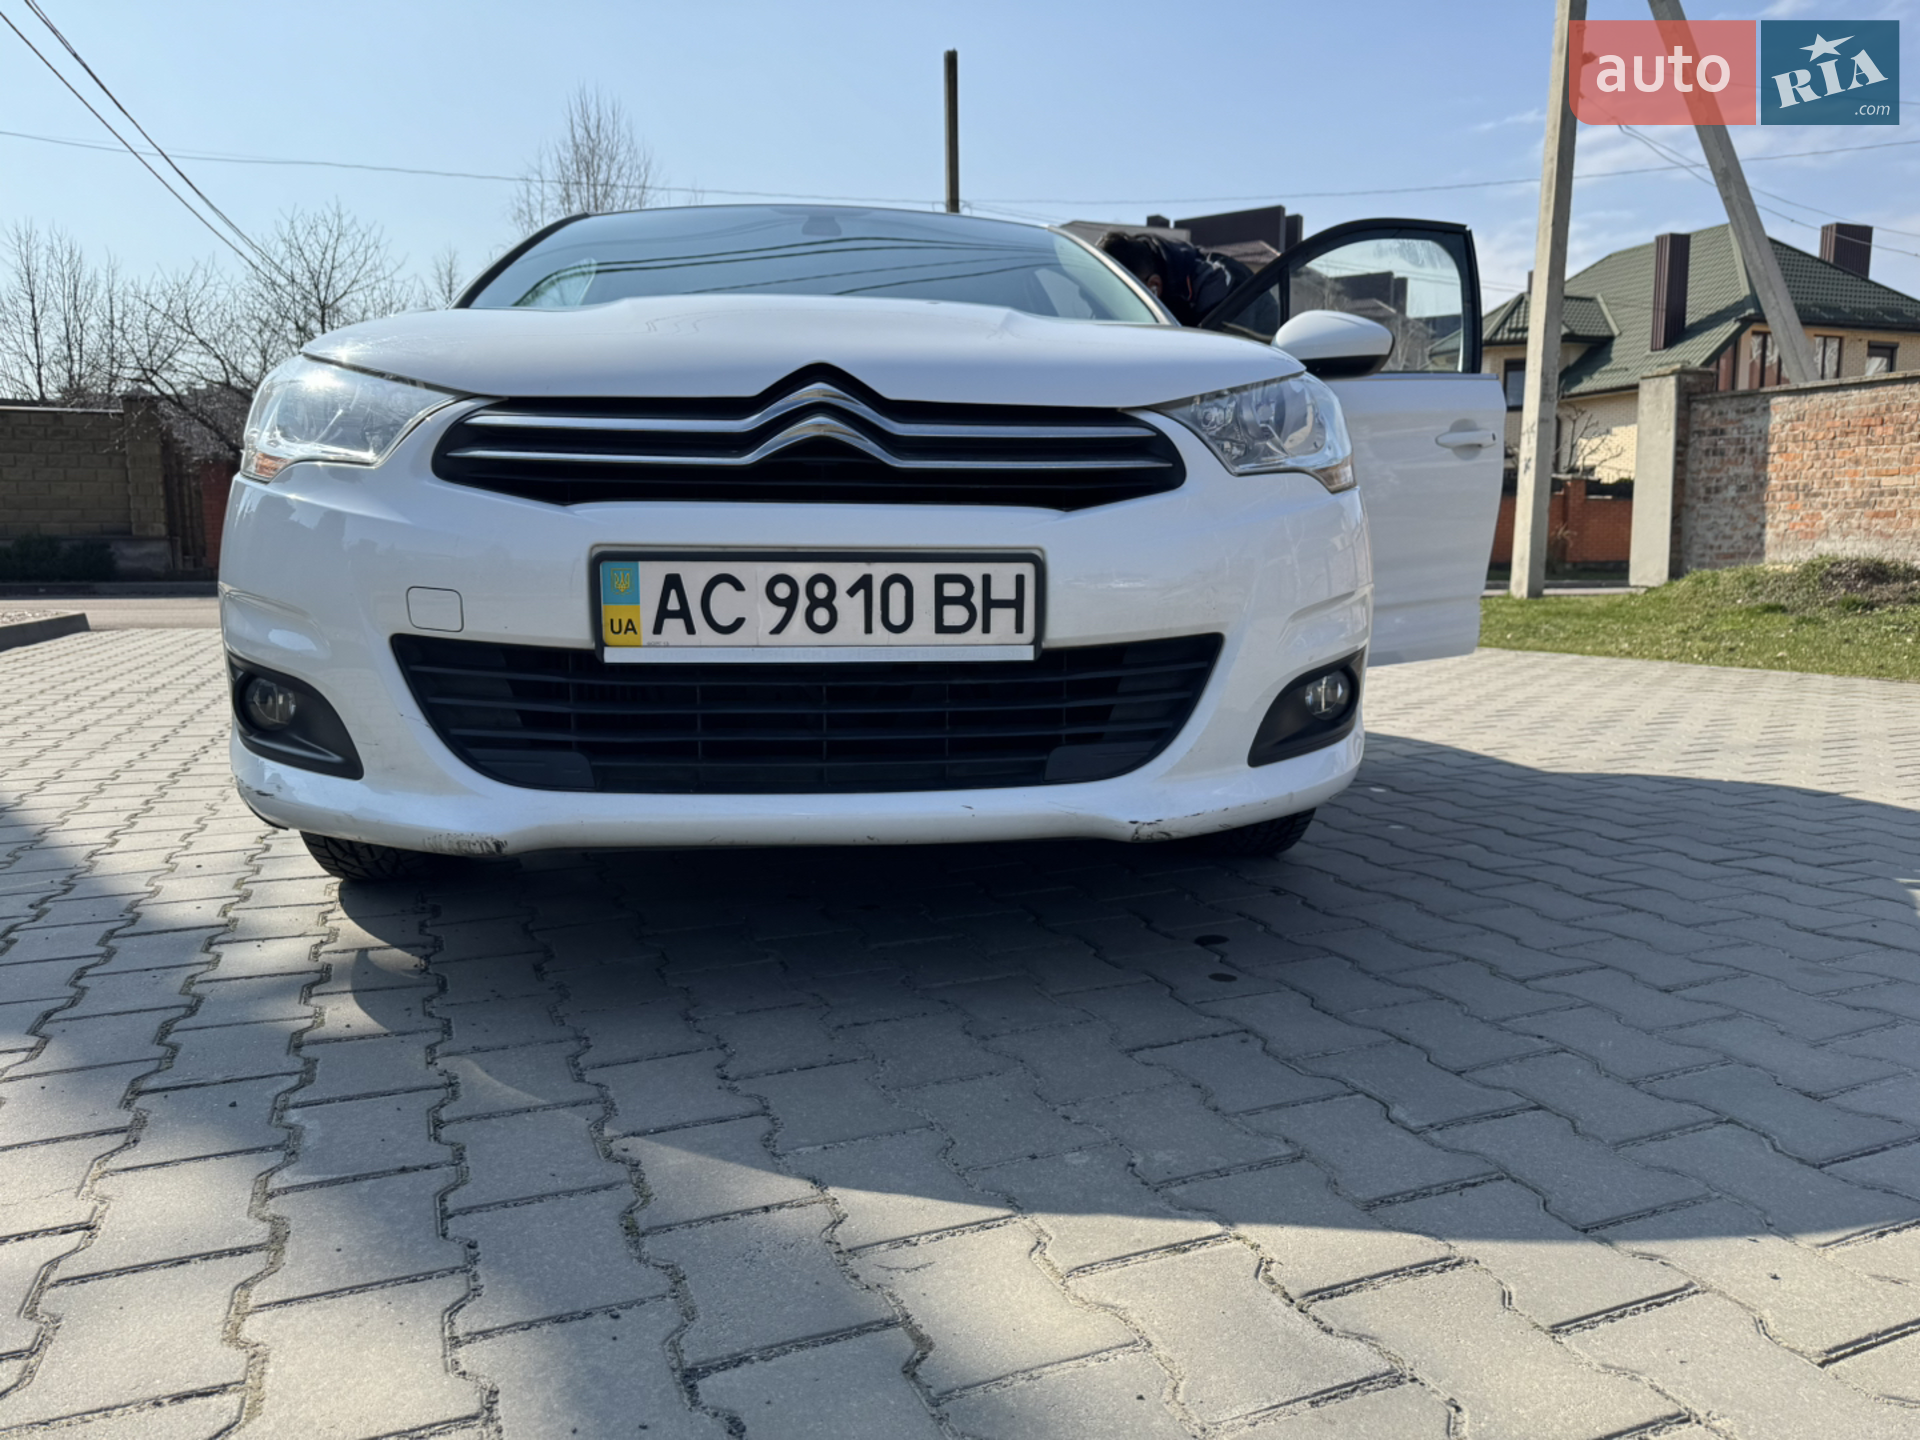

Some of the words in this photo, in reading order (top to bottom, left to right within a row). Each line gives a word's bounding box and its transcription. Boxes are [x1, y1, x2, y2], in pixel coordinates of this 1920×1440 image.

[652, 572, 746, 635] AC
[764, 572, 914, 635] 9810
[934, 573, 1026, 635] BH
[610, 618, 638, 635] UA
